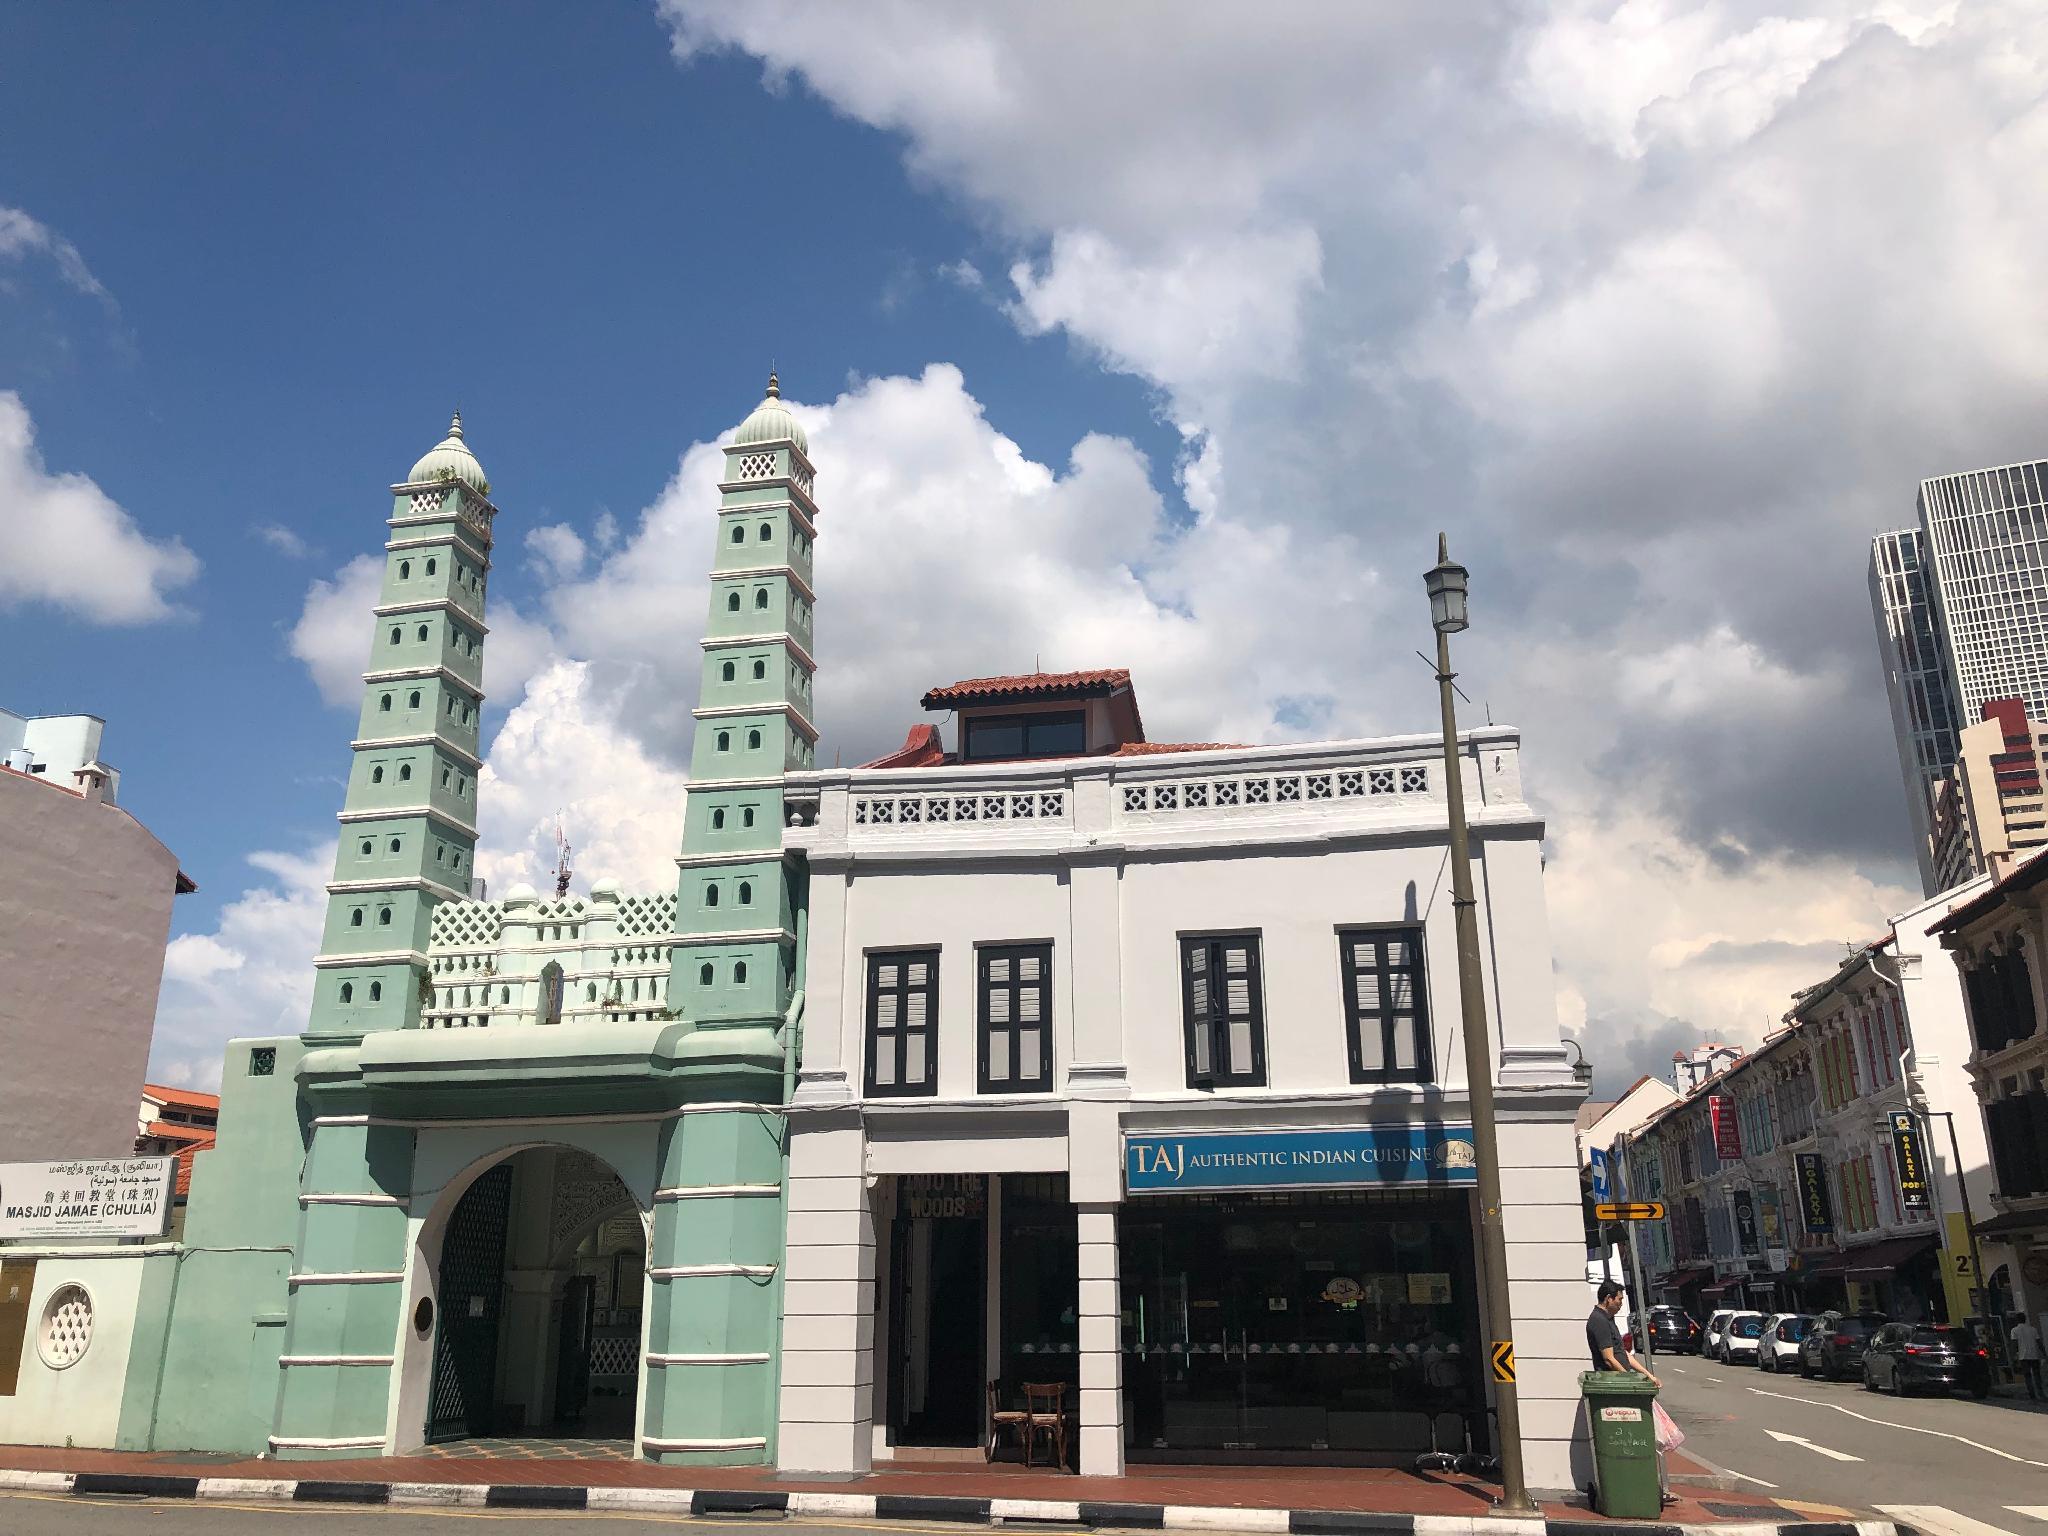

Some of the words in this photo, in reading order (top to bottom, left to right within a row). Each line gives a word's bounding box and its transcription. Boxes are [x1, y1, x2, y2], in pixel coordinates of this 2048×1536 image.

[1130, 1144, 1185, 1181] TAJ
[1189, 1152, 1287, 1168] AUTHENTIC
[1292, 1149, 1356, 1165] INDIAN
[1361, 1147, 1432, 1162] CUISINE
[1456, 1152, 1471, 1161] TAJ
[1902, 1136, 1915, 1178] GALAXY
[5, 1206, 51, 1219] MASJID
[55, 1204, 98, 1218] JAMAE
[102, 1202, 157, 1217] (CHULIA)
[911, 1197, 966, 1217] WOODS
[1956, 1255, 1972, 1272] 2
